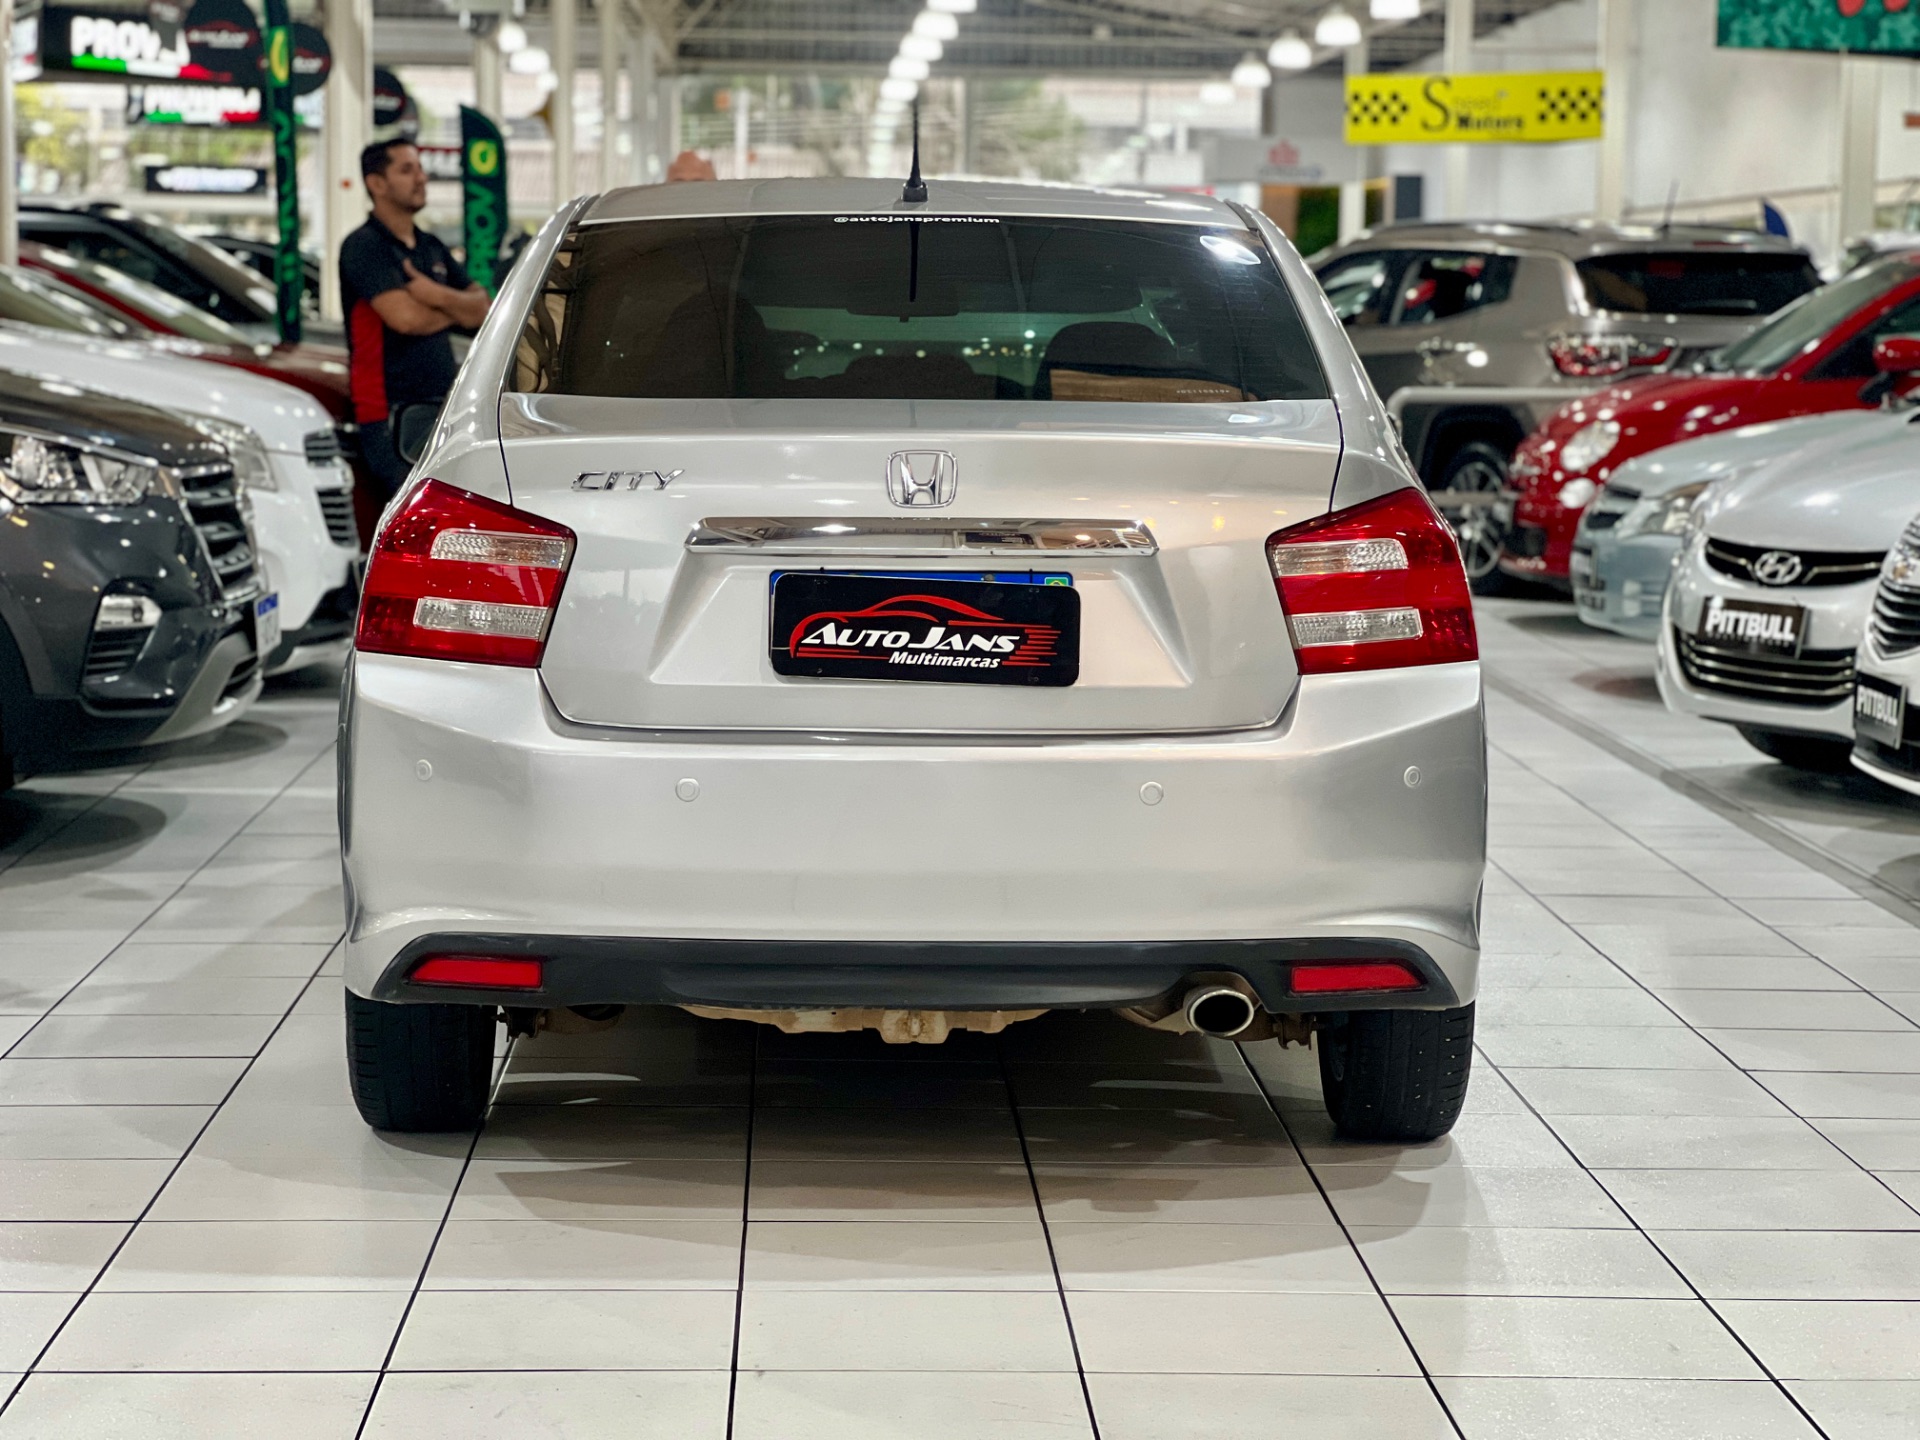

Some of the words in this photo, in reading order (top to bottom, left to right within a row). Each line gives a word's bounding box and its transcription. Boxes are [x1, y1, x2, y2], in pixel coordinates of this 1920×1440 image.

[571, 469, 685, 491] CITY
[1705, 608, 1795, 642] PITTBULL
[888, 650, 1001, 669] Multimarcas
[1856, 685, 1898, 726] PITTBULL
